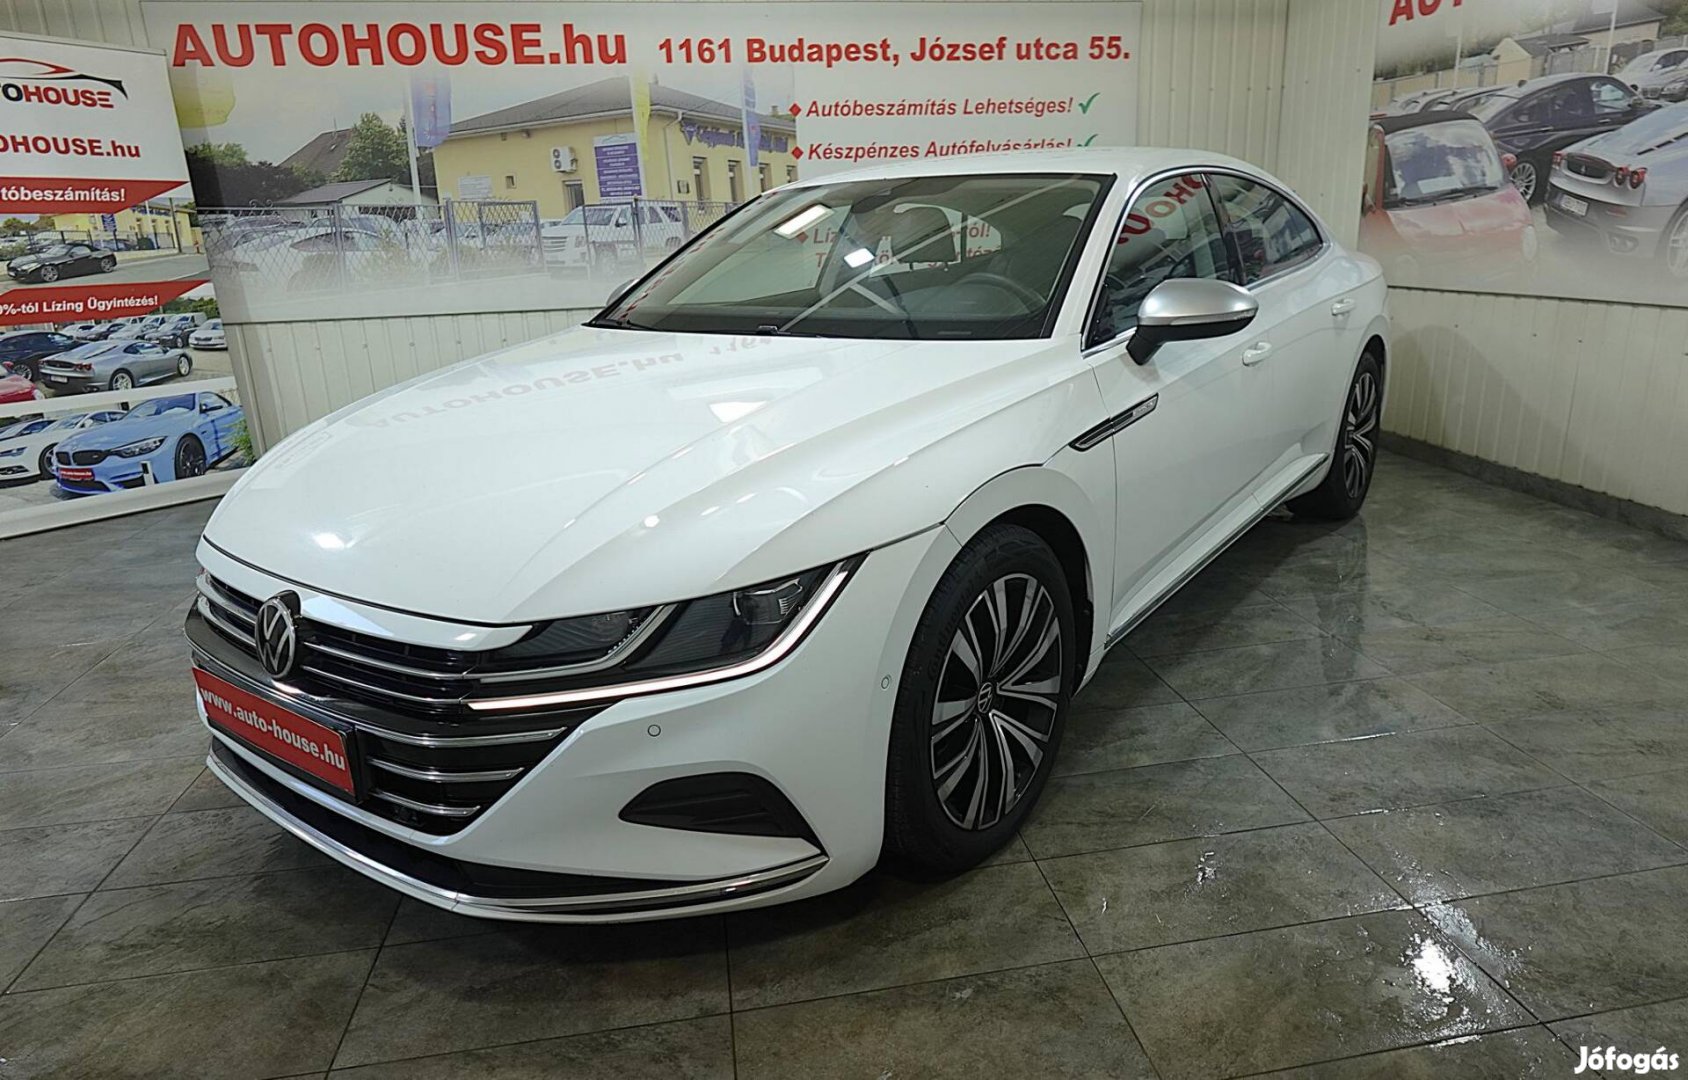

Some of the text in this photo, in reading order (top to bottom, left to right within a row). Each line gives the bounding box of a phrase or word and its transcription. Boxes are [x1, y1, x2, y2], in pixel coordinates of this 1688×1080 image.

[172, 22, 1131, 69] AUTOHOUSE.hu 1161 Budapest, József utca 55.
[0, 83, 114, 109] OHOUSE
[806, 97, 1073, 118] Autóbeszámítás Lehetséges!
[808, 142, 919, 161] Készpénzes
[0, 186, 126, 202] tóbeszámítás!
[43, 301, 84, 313] Lízing
[87, 295, 158, 311] Ügyintézés!
[200, 686, 346, 771] www.auto-house.hu
